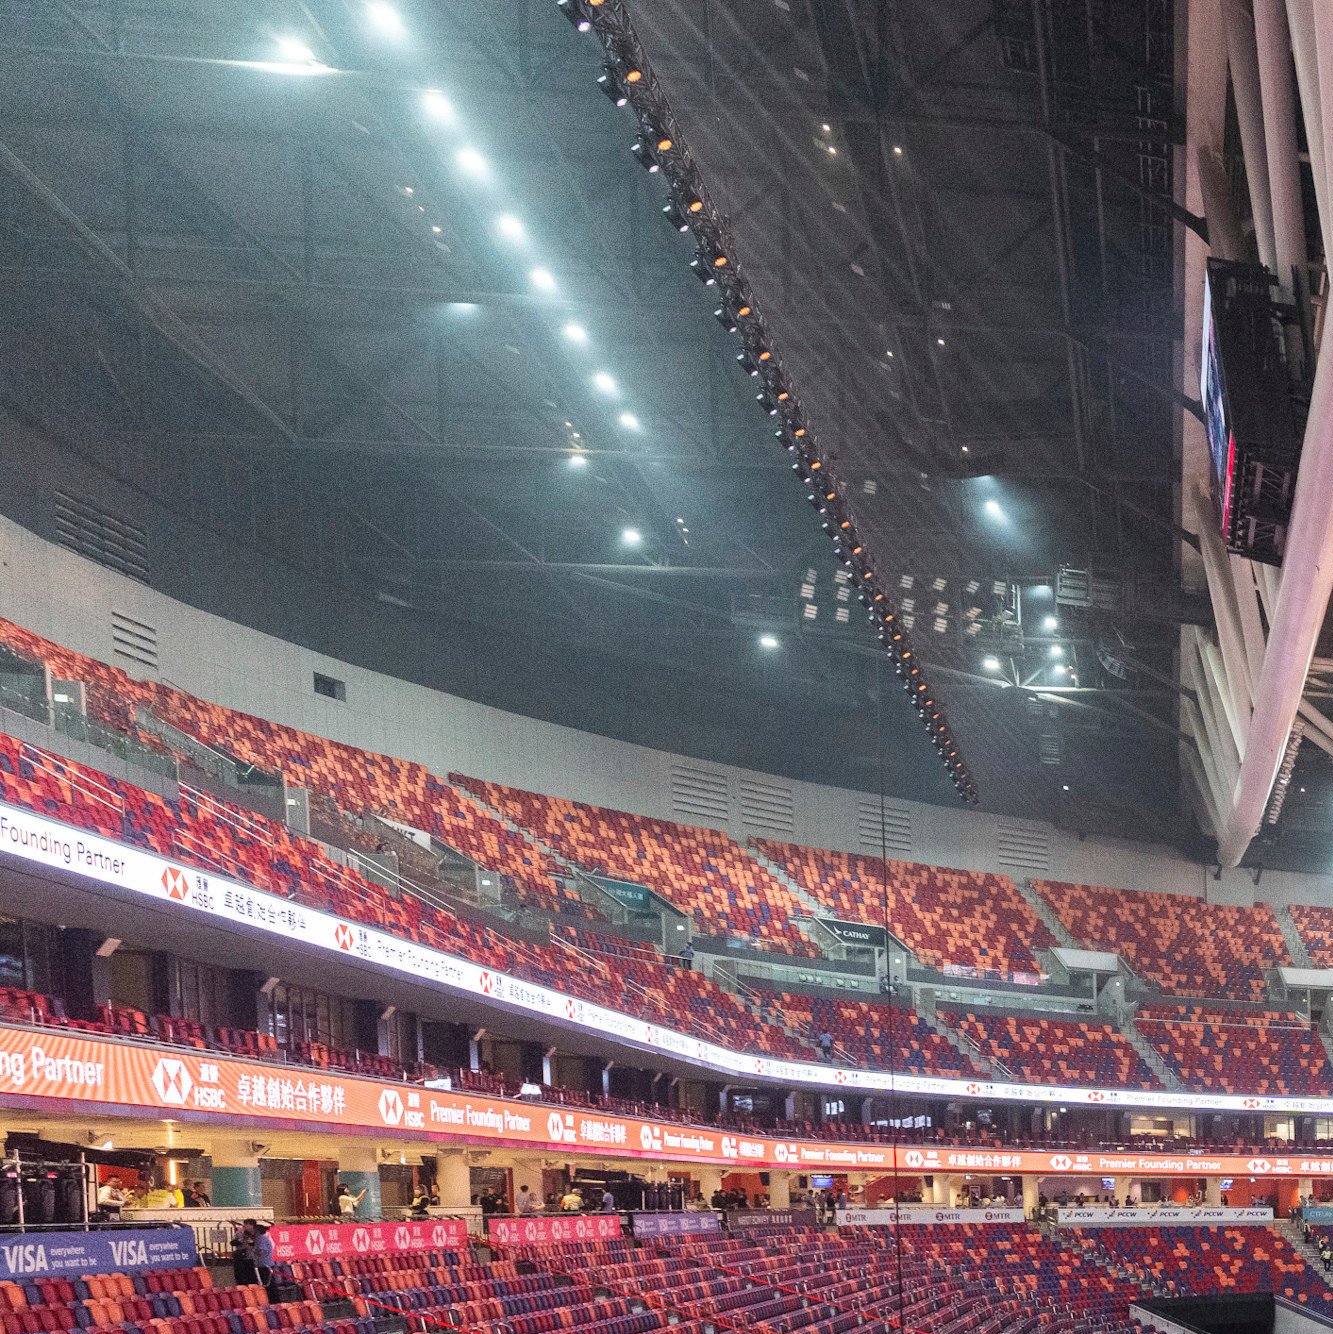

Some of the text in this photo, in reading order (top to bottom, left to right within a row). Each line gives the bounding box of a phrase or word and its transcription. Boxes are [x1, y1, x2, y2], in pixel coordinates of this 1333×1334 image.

[1, 817, 125, 876] Founding Partner
[843, 930, 870, 940] CATHAY
[32, 1046, 104, 1086] Partner
[194, 1086, 226, 1108] HSBC
[237, 1074, 346, 1116] 卓越創始合作夥伴
[404, 1110, 425, 1128] HSBC
[430, 1100, 530, 1133] Premier Founding Partner
[801, 1147, 885, 1164] Premier Founding Partner
[1072, 1163, 1092, 1171] HSBC
[1099, 1158, 1221, 1172] Premier Founding Partner
[1272, 1166, 1292, 1174] HSBC
[150, 1242, 178, 1252] everywhere
[326, 1243, 343, 1254] HSBC
[371, 1241, 387, 1251] HSBC
[411, 1238, 425, 1249] HSBC
[1, 1244, 49, 1273] VISA
[51, 1247, 85, 1257] everywhere
[108, 1240, 149, 1266] VISA
[150, 1252, 189, 1264] you want to be
[276, 1246, 295, 1258] HSBC
[51, 1257, 97, 1270] you want to be
